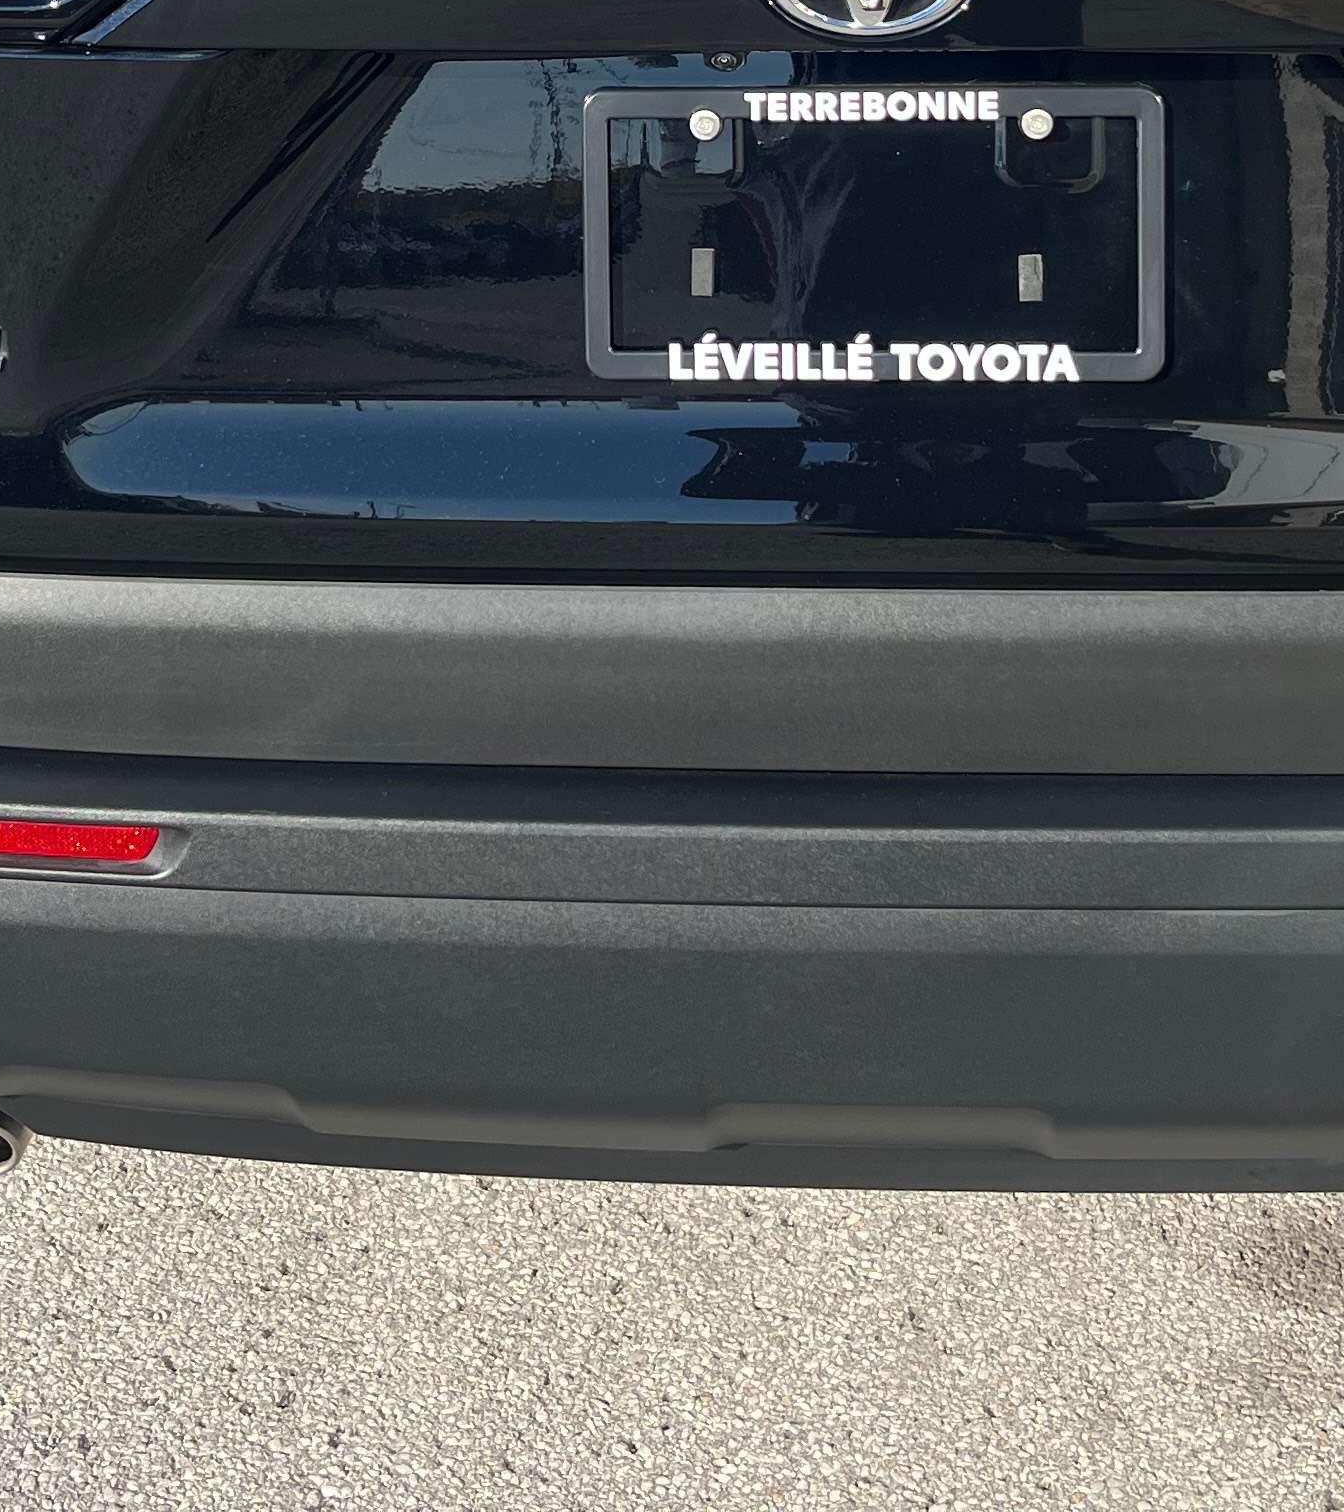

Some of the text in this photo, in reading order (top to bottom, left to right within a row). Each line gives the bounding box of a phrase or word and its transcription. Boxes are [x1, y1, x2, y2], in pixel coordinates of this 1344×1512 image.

[744, 90, 1000, 123] TERREBONNE
[667, 332, 1080, 383] LÉVEILLÉ TOYOTA
